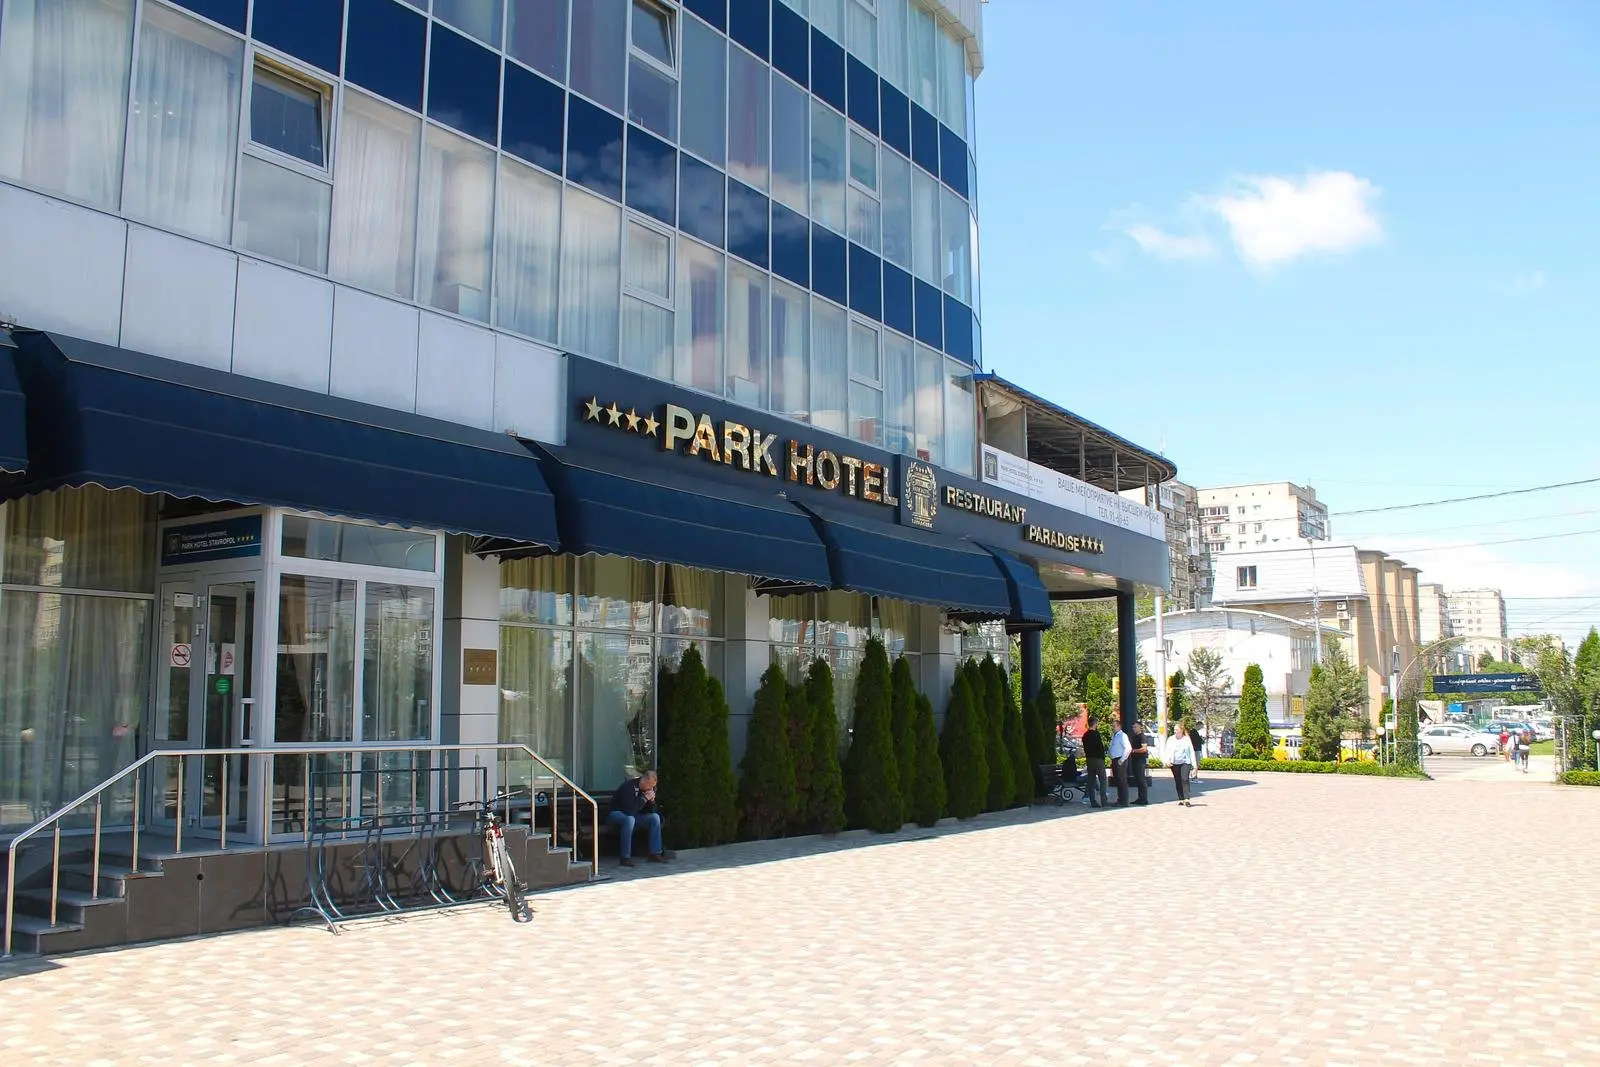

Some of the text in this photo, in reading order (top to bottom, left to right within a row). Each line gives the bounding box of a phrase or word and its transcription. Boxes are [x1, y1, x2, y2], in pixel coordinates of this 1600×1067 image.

[664, 403, 899, 507] PARK HOTEL
[946, 485, 1027, 524] RESTAURANT
[1029, 524, 1080, 552] PARADISE
